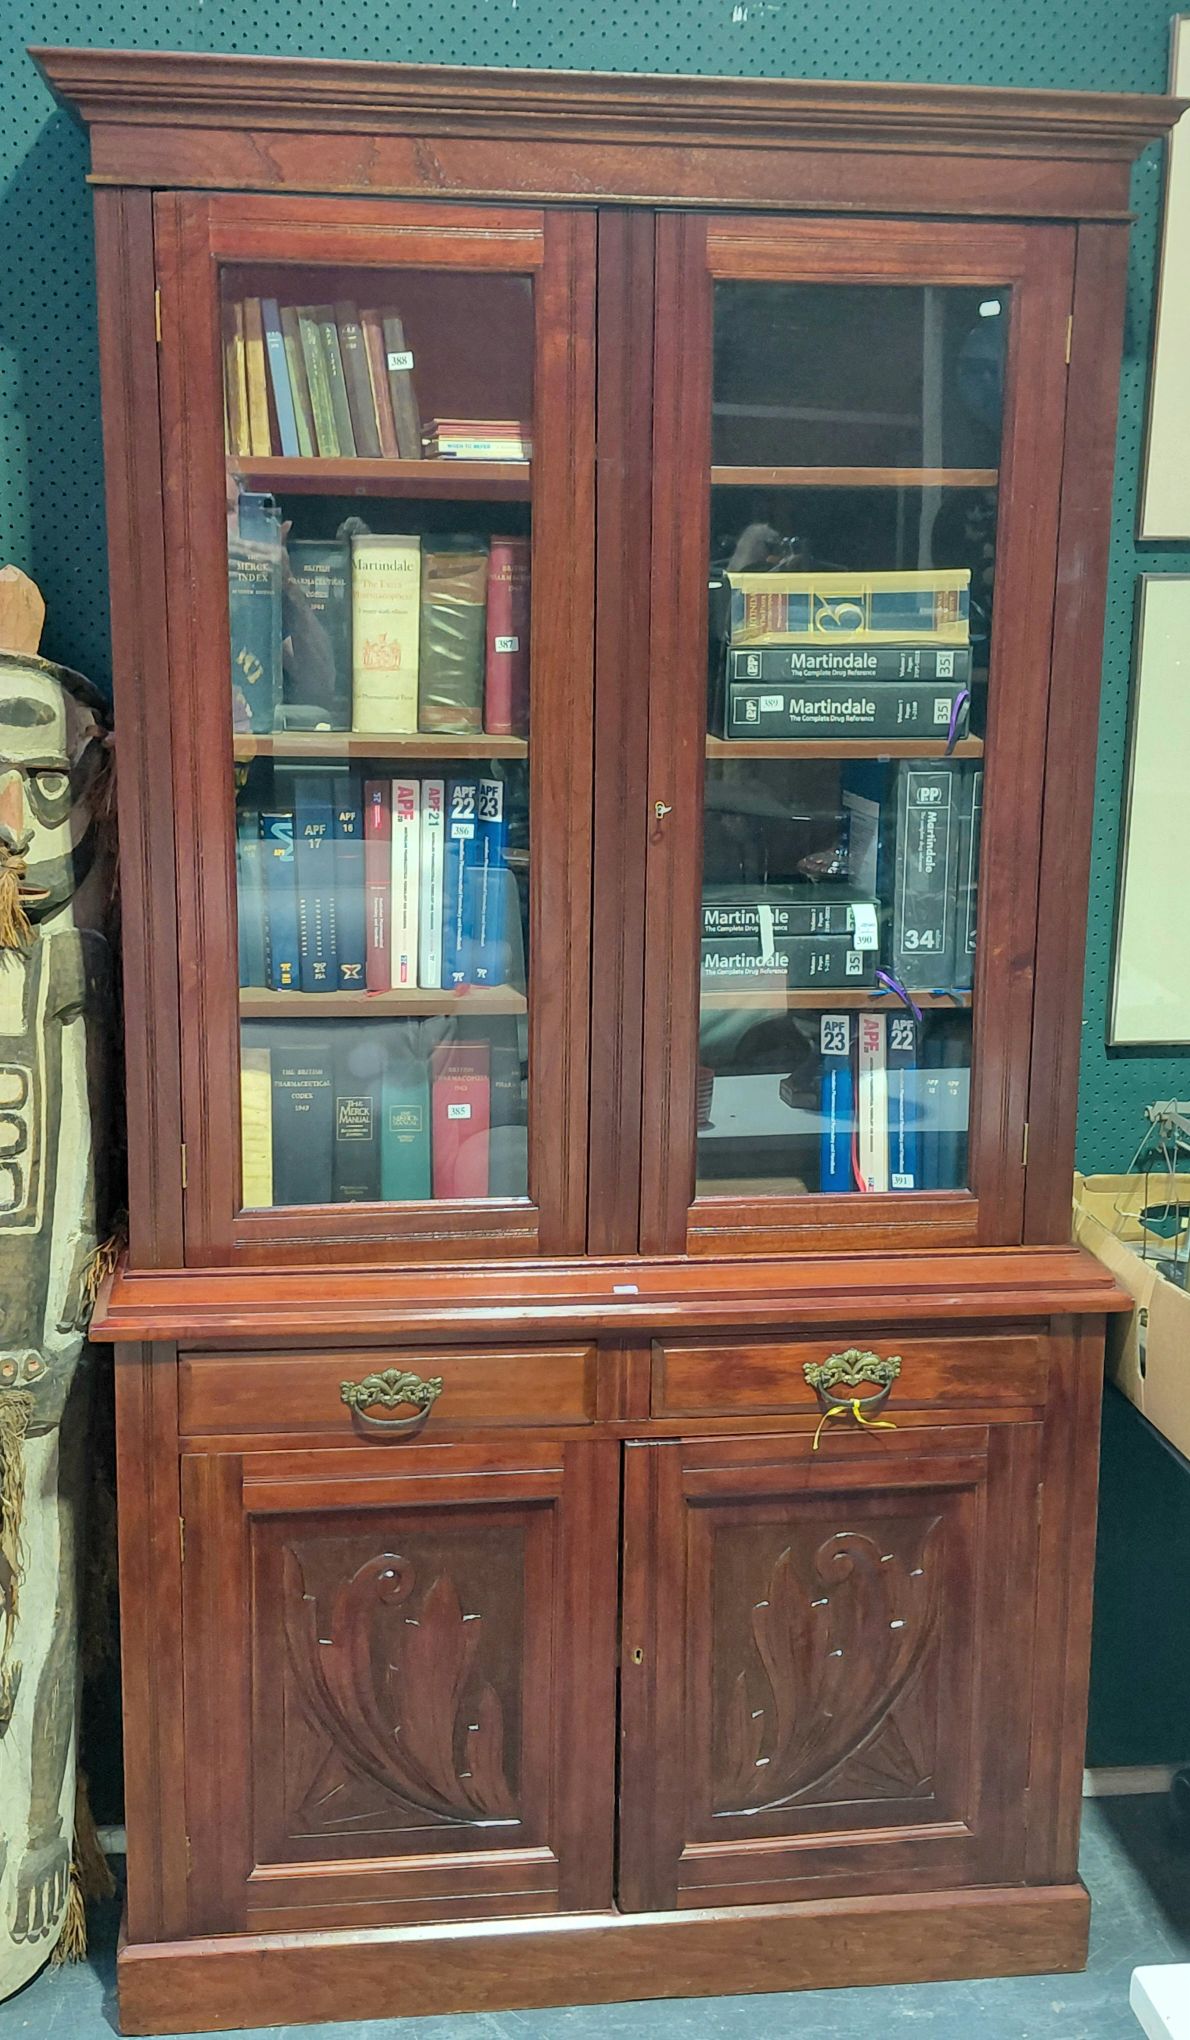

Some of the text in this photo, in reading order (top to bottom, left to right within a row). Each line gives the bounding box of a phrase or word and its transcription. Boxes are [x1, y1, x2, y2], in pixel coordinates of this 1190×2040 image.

[391, 356, 408, 367] 388
[236, 561, 270, 571] MERCK
[352, 558, 414, 572] Martindale
[238, 573, 269, 582] INDEX
[497, 639, 514, 649] 387
[790, 652, 878, 669] Martindale
[939, 658, 951, 675] 35
[789, 698, 876, 714] Martindale
[937, 705, 949, 721] 35
[452, 786, 477, 798] APF
[479, 785, 499, 797] APF
[397, 785, 415, 820] APF
[451, 798, 475, 819] 22
[480, 797, 498, 818] 23
[339, 811, 356, 821] APF
[304, 824, 327, 836] APF
[453, 826, 470, 836] 386
[308, 838, 322, 849] 17
[925, 811, 938, 873] Martindale
[856, 935, 873, 945] 390
[904, 929, 934, 949] 34
[849, 956, 860, 972] 35
[824, 1020, 846, 1031] APF
[892, 1019, 914, 1031] APF
[863, 1018, 879, 1051] APF
[823, 1031, 846, 1051] 23
[890, 1031, 913, 1051] 22
[340, 1105, 370, 1117] MERCK
[451, 1106, 466, 1115] 385
[339, 1114, 370, 1124] MANUAL
[894, 1176, 908, 1185] 391
